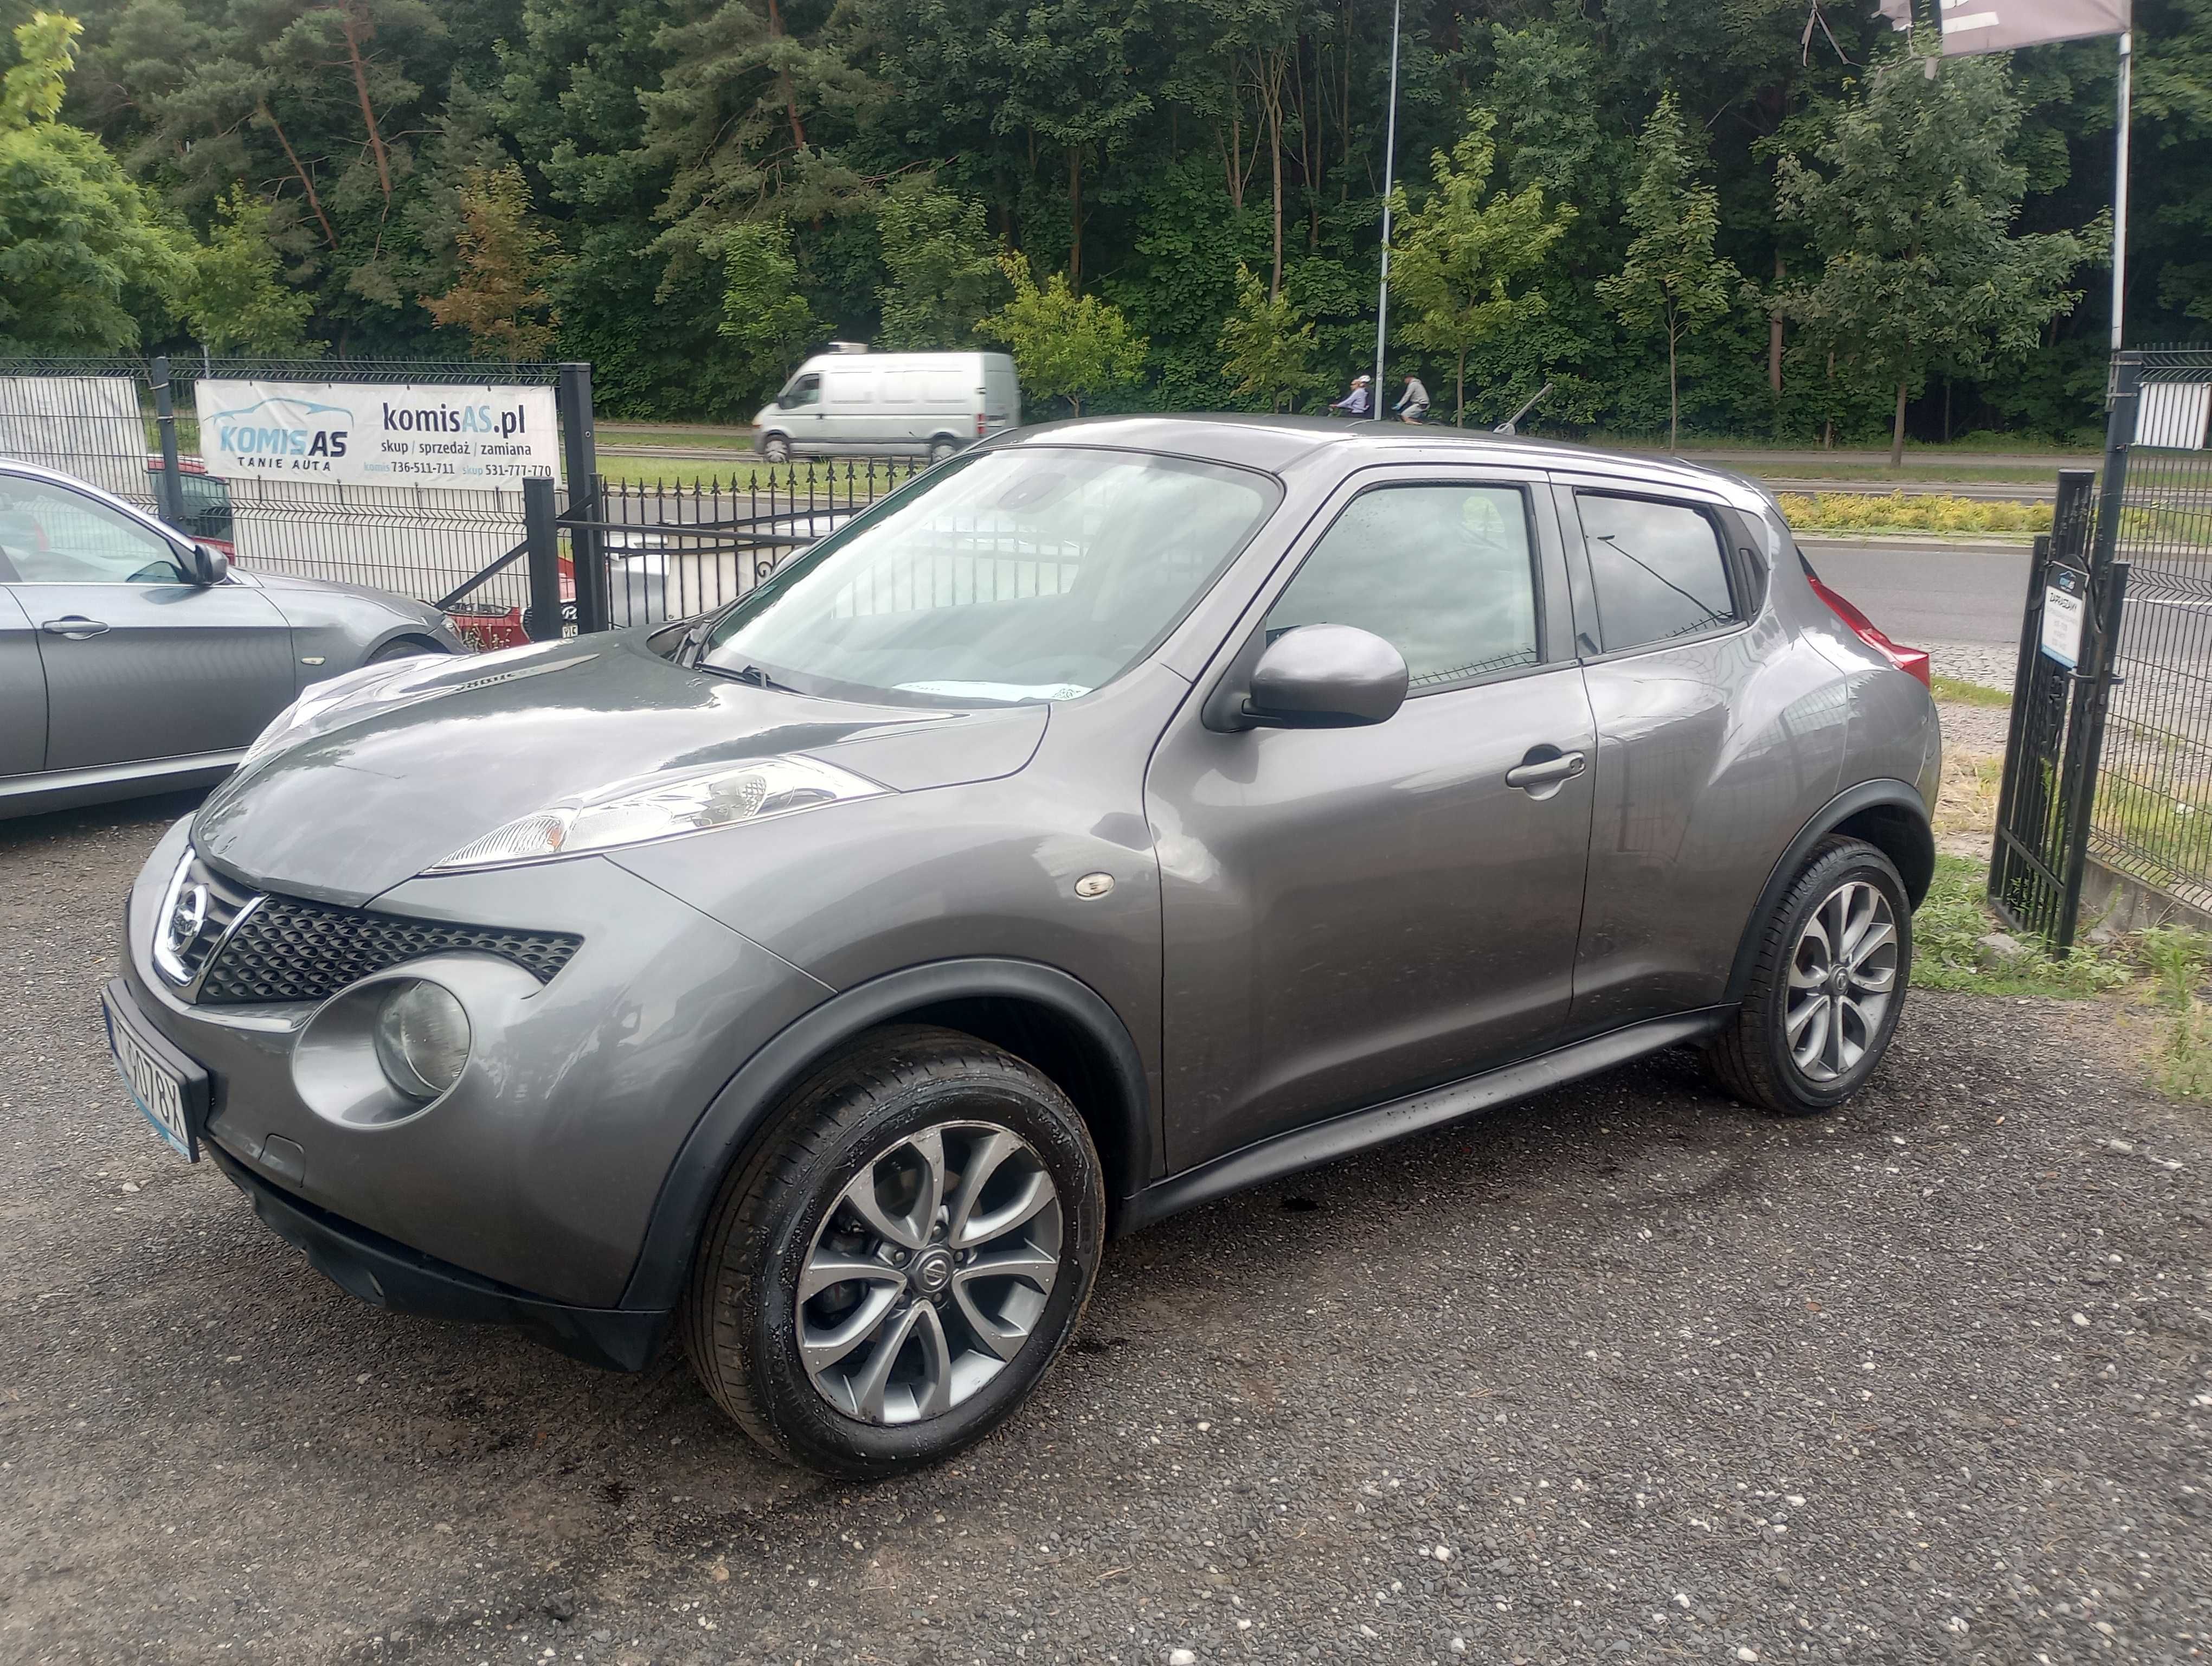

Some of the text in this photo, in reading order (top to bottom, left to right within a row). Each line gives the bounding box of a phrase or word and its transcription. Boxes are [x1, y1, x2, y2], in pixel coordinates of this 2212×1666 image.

[383, 402, 525, 438] komisAS.pl
[381, 440, 408, 453] skup
[419, 442, 471, 456] sprzedaż
[481, 442, 531, 456] zamiana
[237, 457, 330, 471] TANIE AUTA
[391, 462, 455, 474] 736-511-711
[485, 464, 551, 477] 531-777-770
